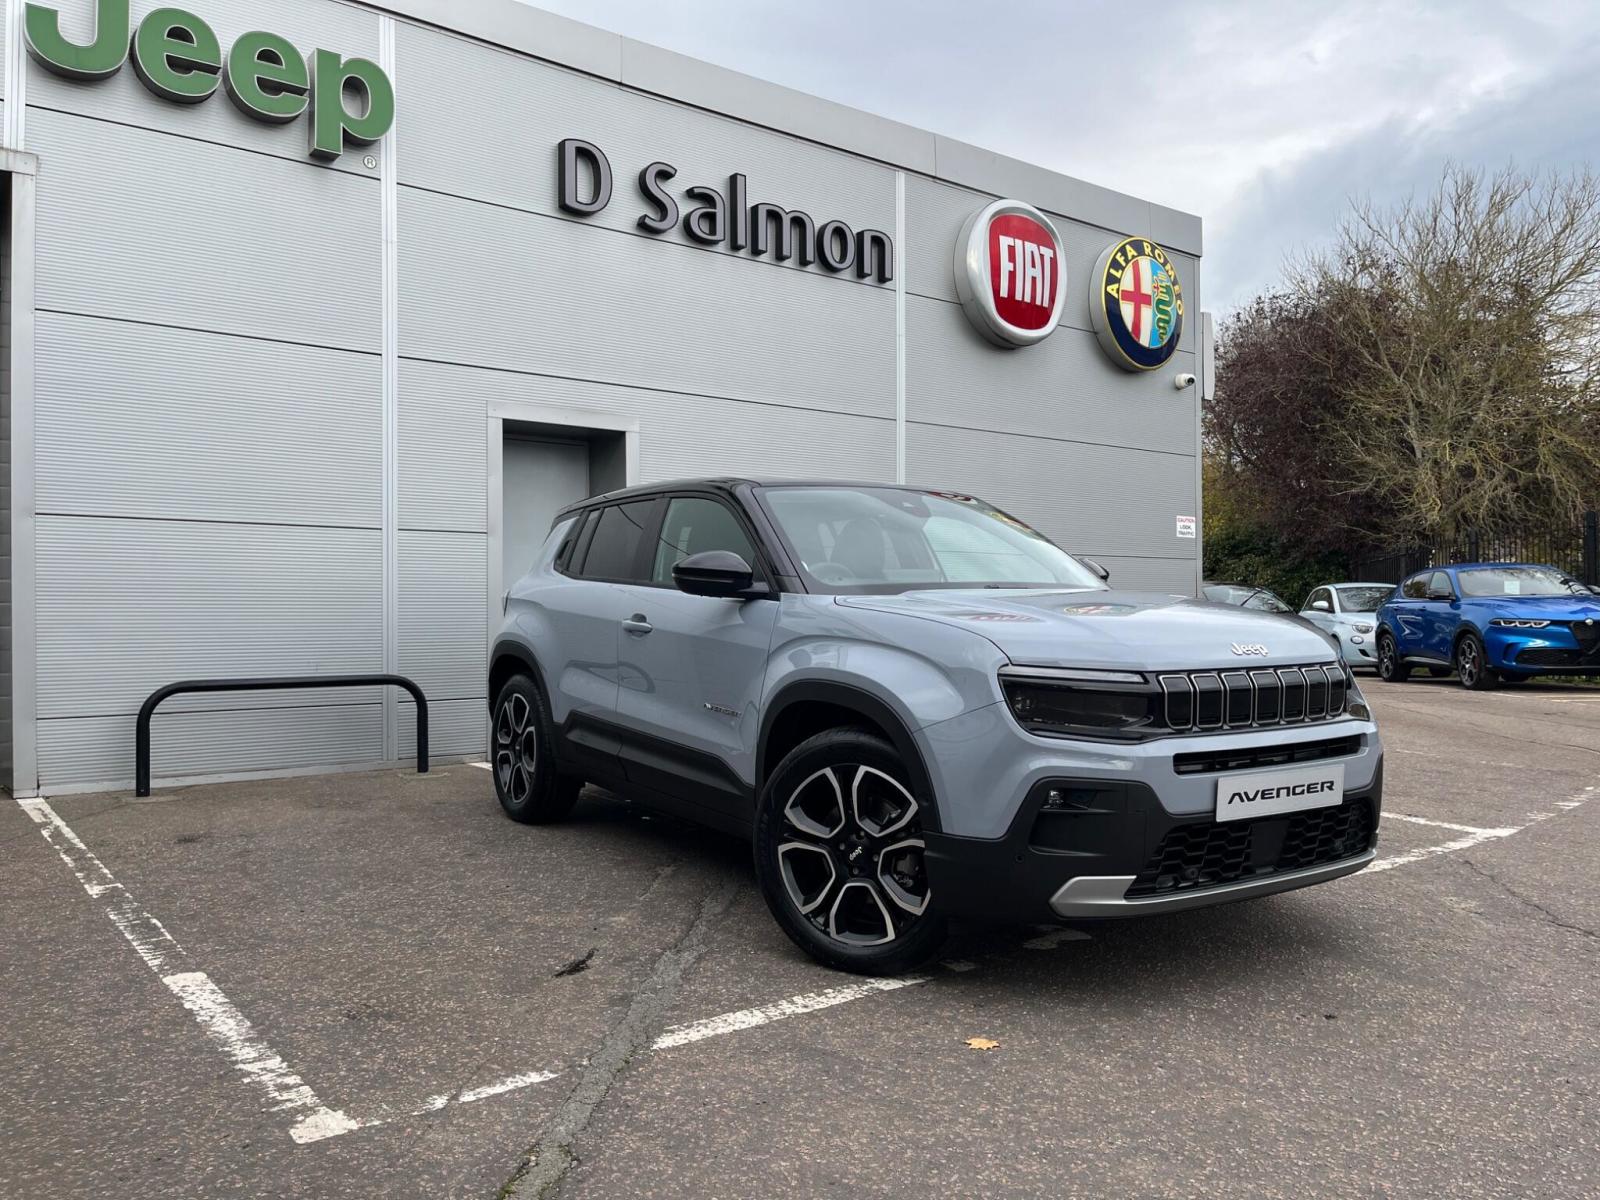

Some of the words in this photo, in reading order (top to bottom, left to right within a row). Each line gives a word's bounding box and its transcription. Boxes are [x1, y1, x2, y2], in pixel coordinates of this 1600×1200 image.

[25, 0, 395, 162] Jeep
[558, 138, 612, 217] D
[637, 161, 893, 284] Salmon
[999, 234, 1054, 308] FIAT
[1106, 244, 1137, 299] ALFA
[1143, 241, 1184, 316] ROMEO
[1231, 642, 1269, 657] Jeep
[1227, 780, 1335, 805] AVENGER
